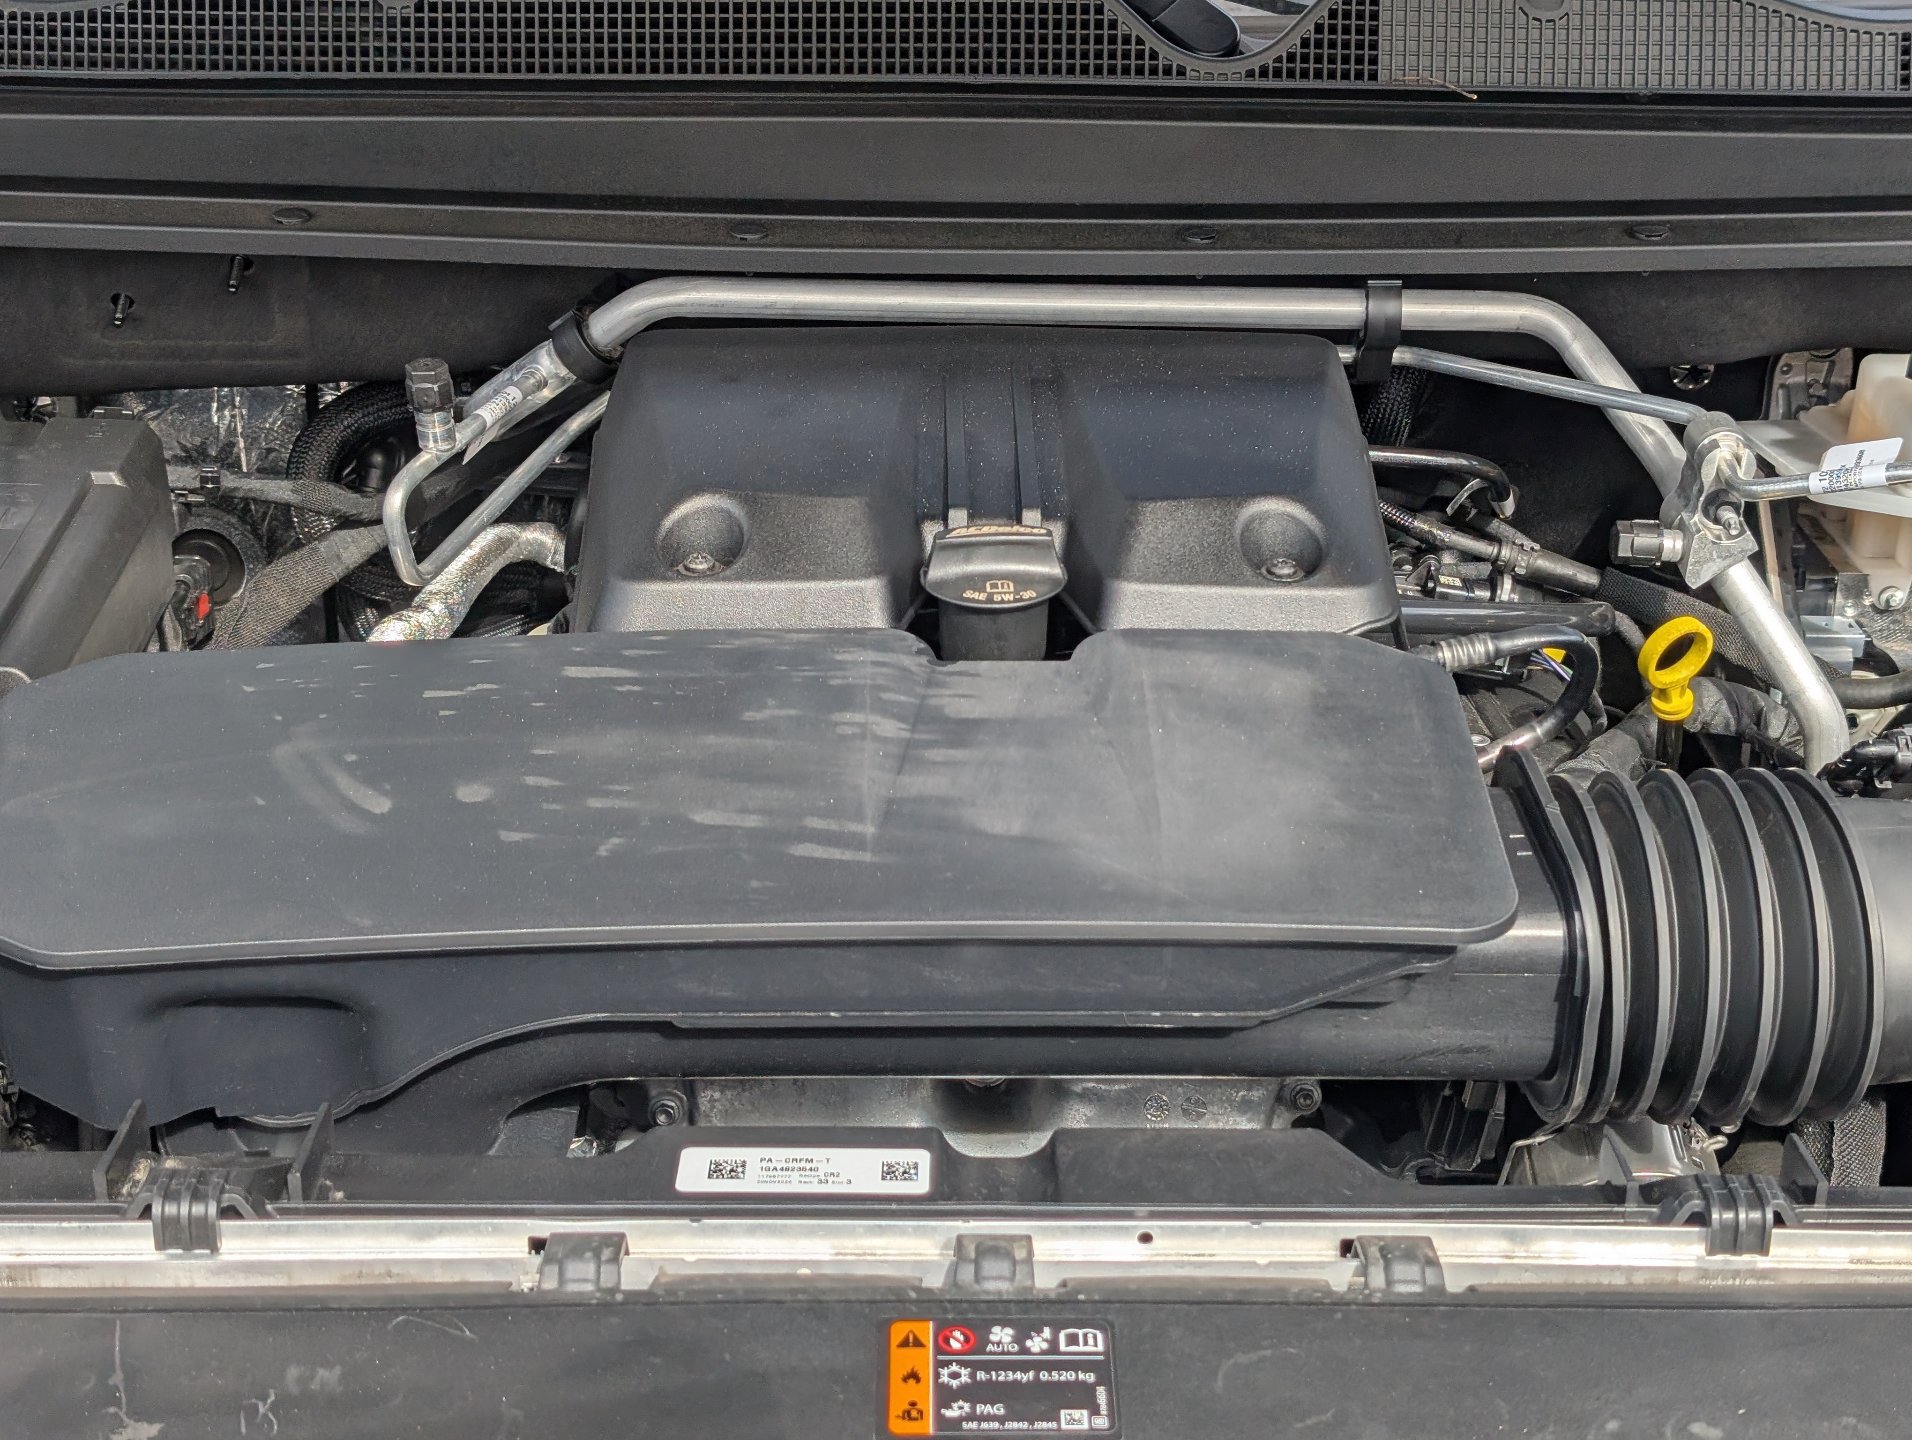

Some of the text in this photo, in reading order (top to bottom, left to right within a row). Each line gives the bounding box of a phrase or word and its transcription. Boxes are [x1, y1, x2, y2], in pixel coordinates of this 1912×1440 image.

[962, 589, 1037, 602] SAE 5W-30
[986, 1343, 1019, 1352] AUTO
[976, 1370, 1095, 1383] R-1234yf 0.520 kg
[976, 1403, 1005, 1415] PAG
[962, 1421, 978, 1429] SAE
[1033, 1421, 1057, 1429] J2845
